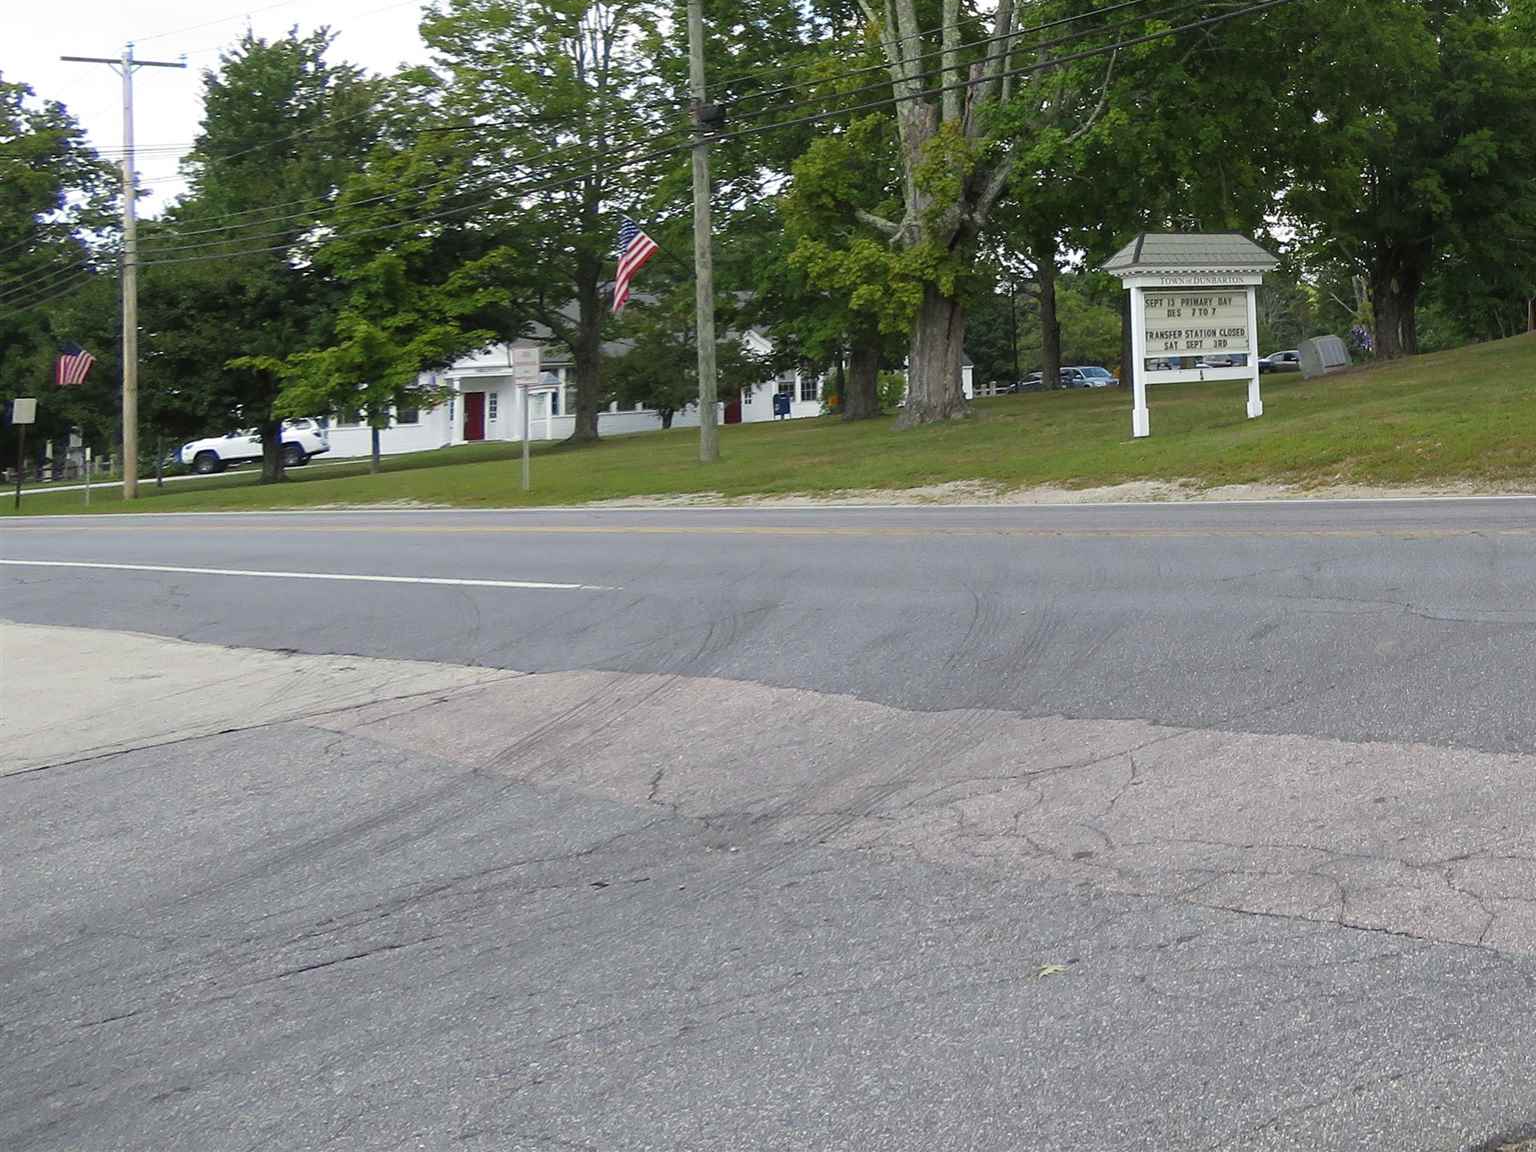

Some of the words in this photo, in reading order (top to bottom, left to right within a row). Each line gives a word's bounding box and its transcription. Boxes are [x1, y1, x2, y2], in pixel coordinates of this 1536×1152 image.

[1161, 277, 1185, 285] TOWN
[1144, 298, 1163, 308] SEPT
[1167, 298, 1175, 306] 13
[1181, 297, 1213, 307] PRIMARY
[1218, 297, 1232, 306] DAY
[1191, 308, 1197, 317] 7
[1199, 308, 1209, 316] TO
[1145, 330, 1182, 340] TRANSFER
[1185, 328, 1217, 338] STATION
[1219, 328, 1245, 337] CLOSED
[1164, 341, 1178, 350] SAT
[1186, 340, 1203, 349] SEPT
[1214, 339, 1228, 348] 3RD
